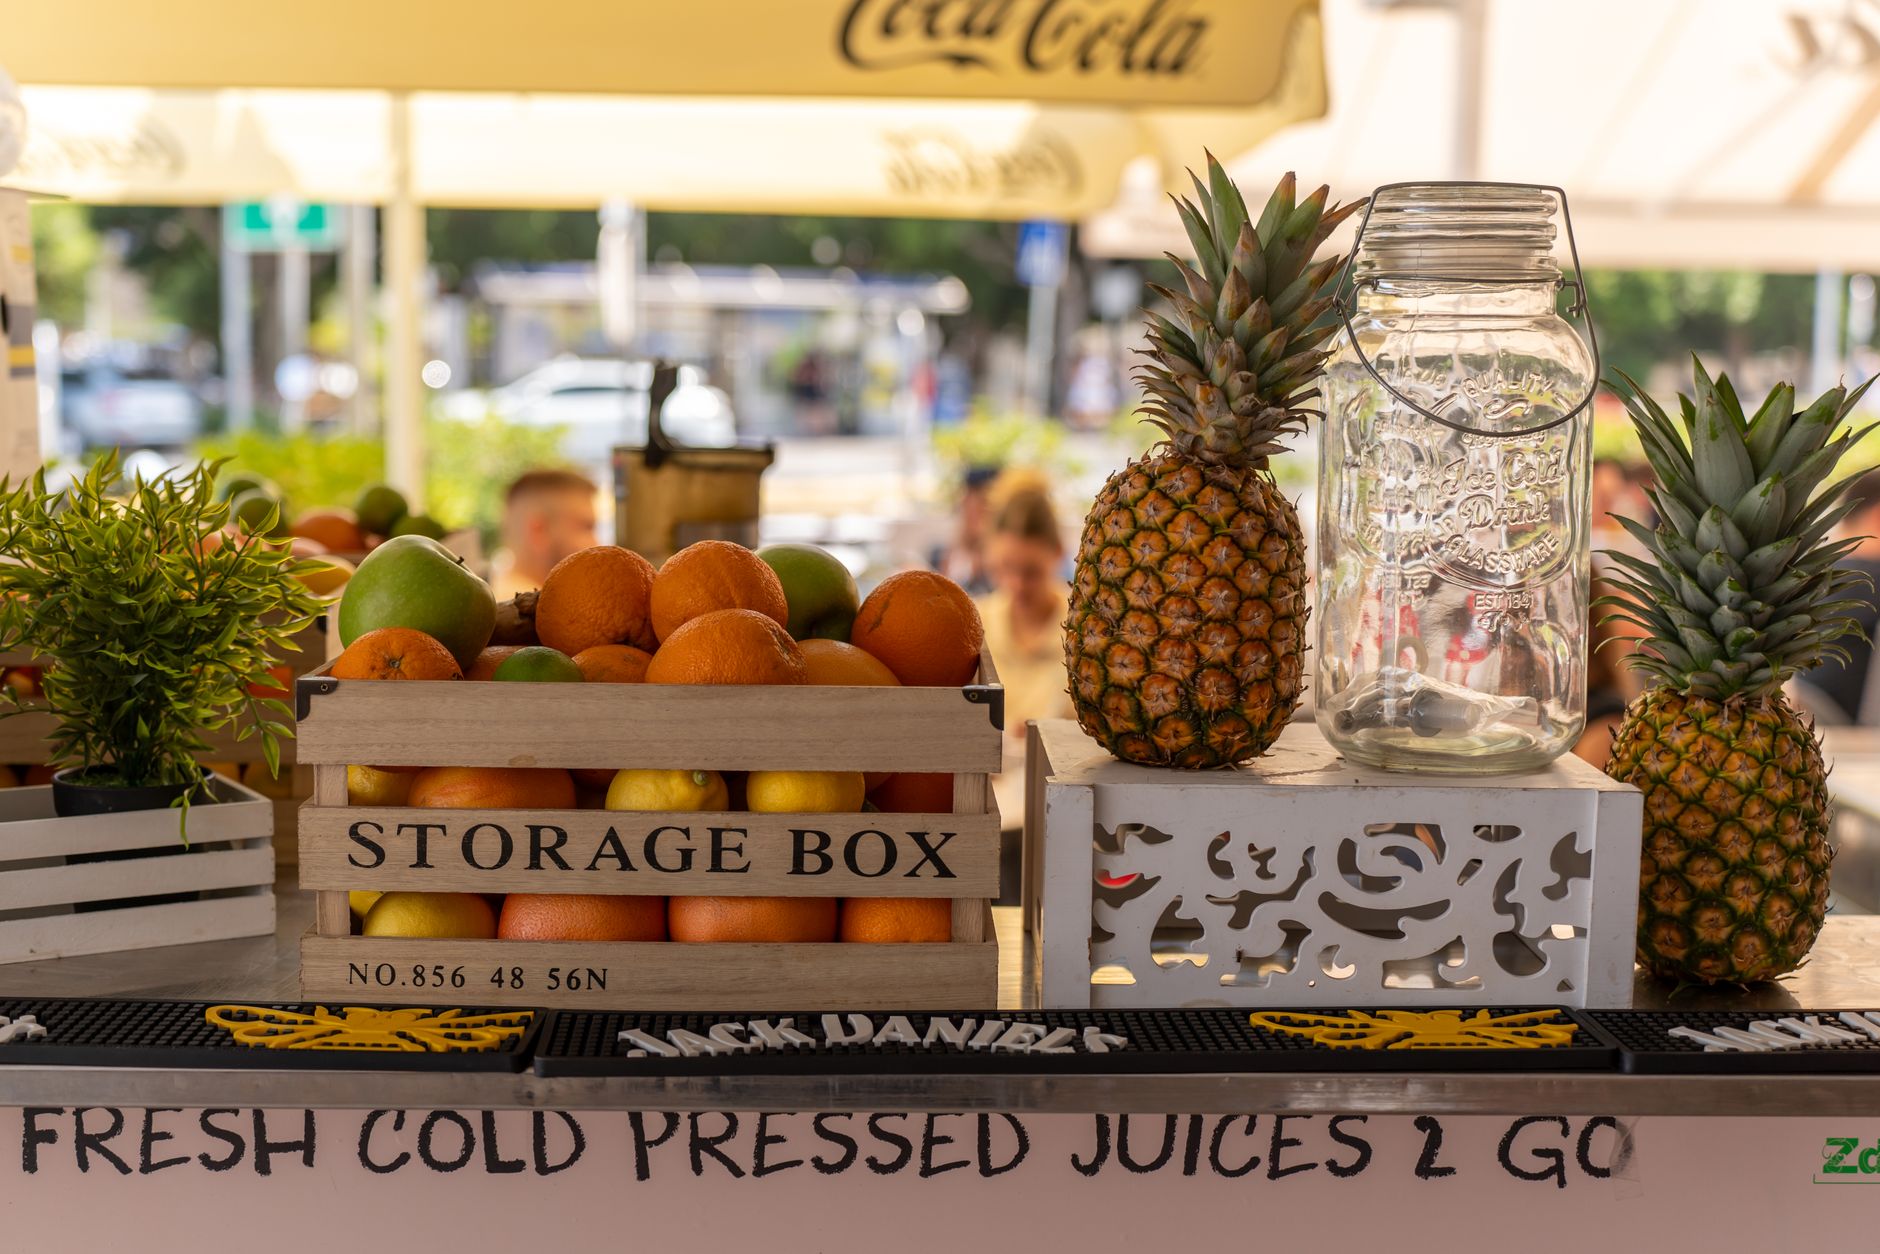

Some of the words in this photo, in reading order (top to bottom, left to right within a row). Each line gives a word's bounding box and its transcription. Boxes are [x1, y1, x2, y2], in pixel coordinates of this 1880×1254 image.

[1462, 368, 1554, 398] QUALITY
[1502, 449, 1567, 490] Cold
[1445, 531, 1560, 573] GLASSWARE
[1474, 592, 1504, 610] EST
[348, 821, 751, 874] STORAGE
[786, 828, 958, 879] BOX
[348, 962, 466, 989] NO.856
[490, 965, 525, 990] 48
[547, 967, 608, 991] 56N
[617, 1017, 817, 1058] JACK
[22, 1107, 316, 1176] FRESH
[357, 1110, 587, 1176] COLD
[628, 1111, 1031, 1182] PRESSED
[1070, 1114, 1373, 1181] JUICES
[1413, 1115, 1457, 1180] 2
[1497, 1115, 1634, 1189] GO
